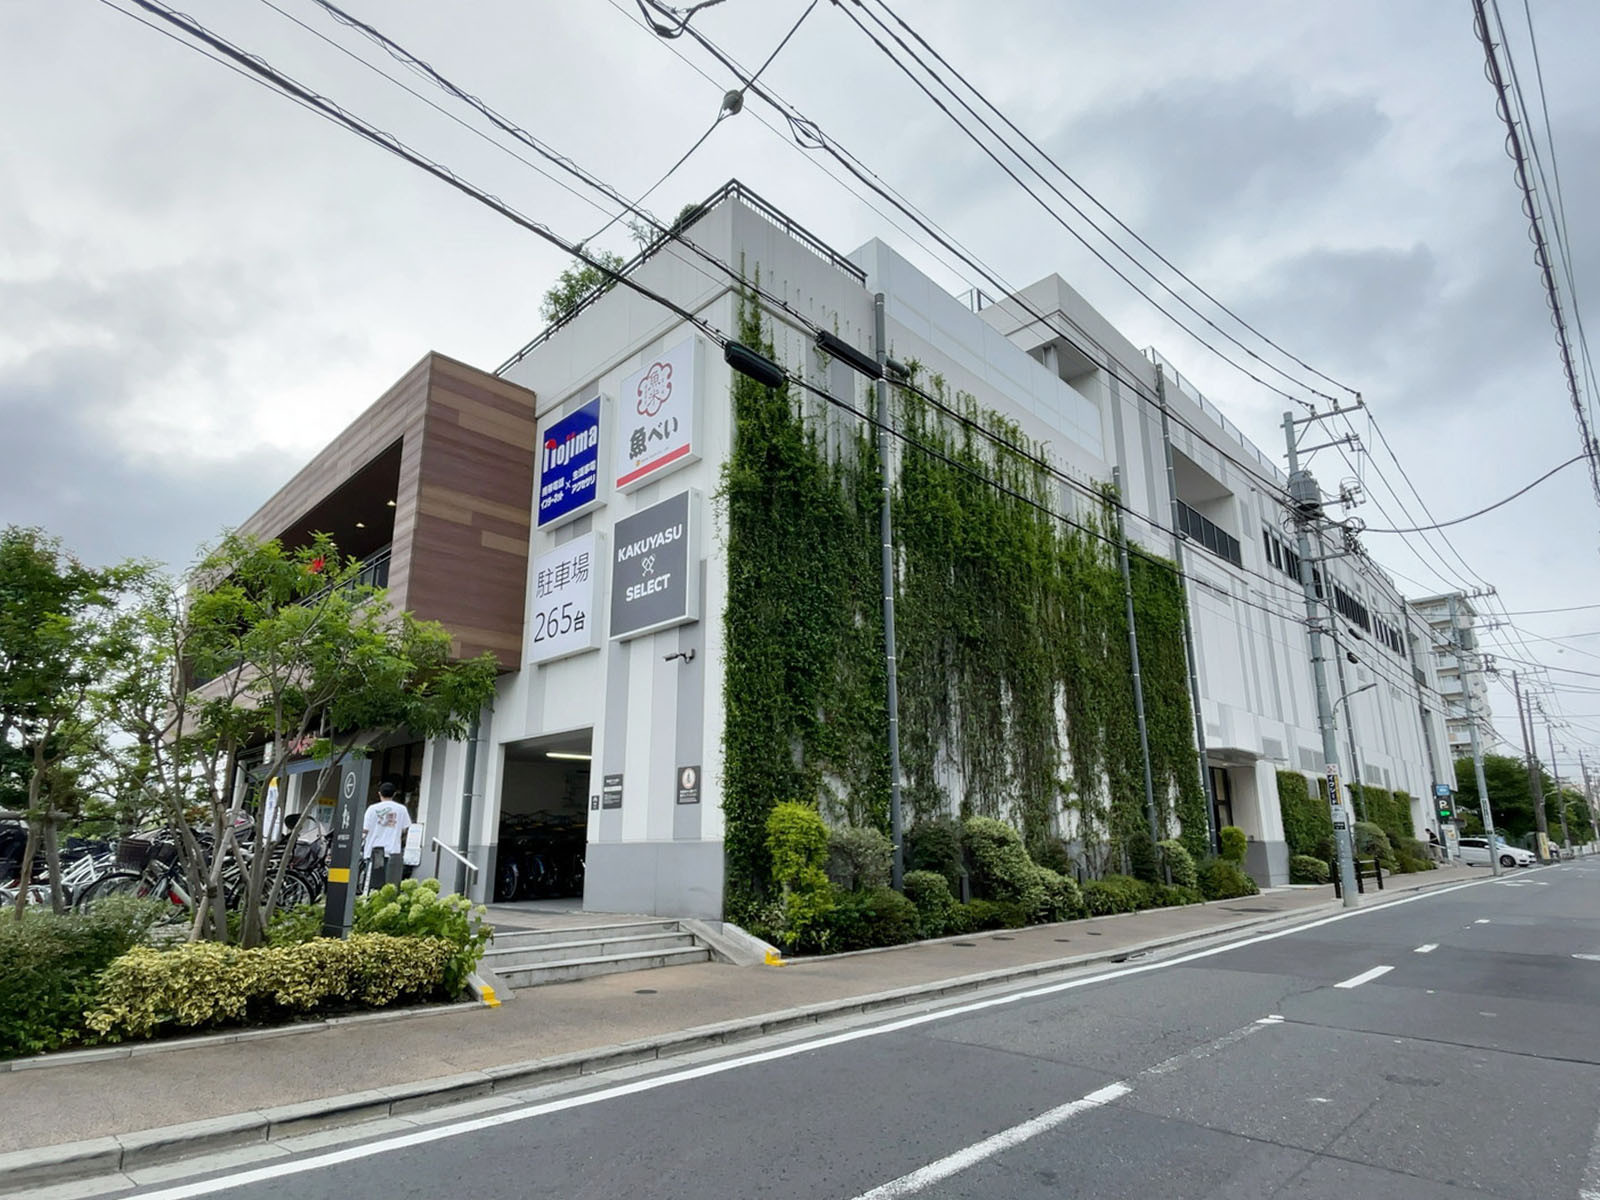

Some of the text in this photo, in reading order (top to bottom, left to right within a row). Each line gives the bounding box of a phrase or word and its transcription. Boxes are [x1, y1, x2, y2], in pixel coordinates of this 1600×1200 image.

[543, 425, 598, 473] nojima
[629, 417, 678, 460] 魚べい
[617, 523, 683, 562] KAKUYASU
[536, 552, 590, 598] 駐車場
[626, 573, 671, 602] SELECT
[534, 602, 586, 643] 265台
